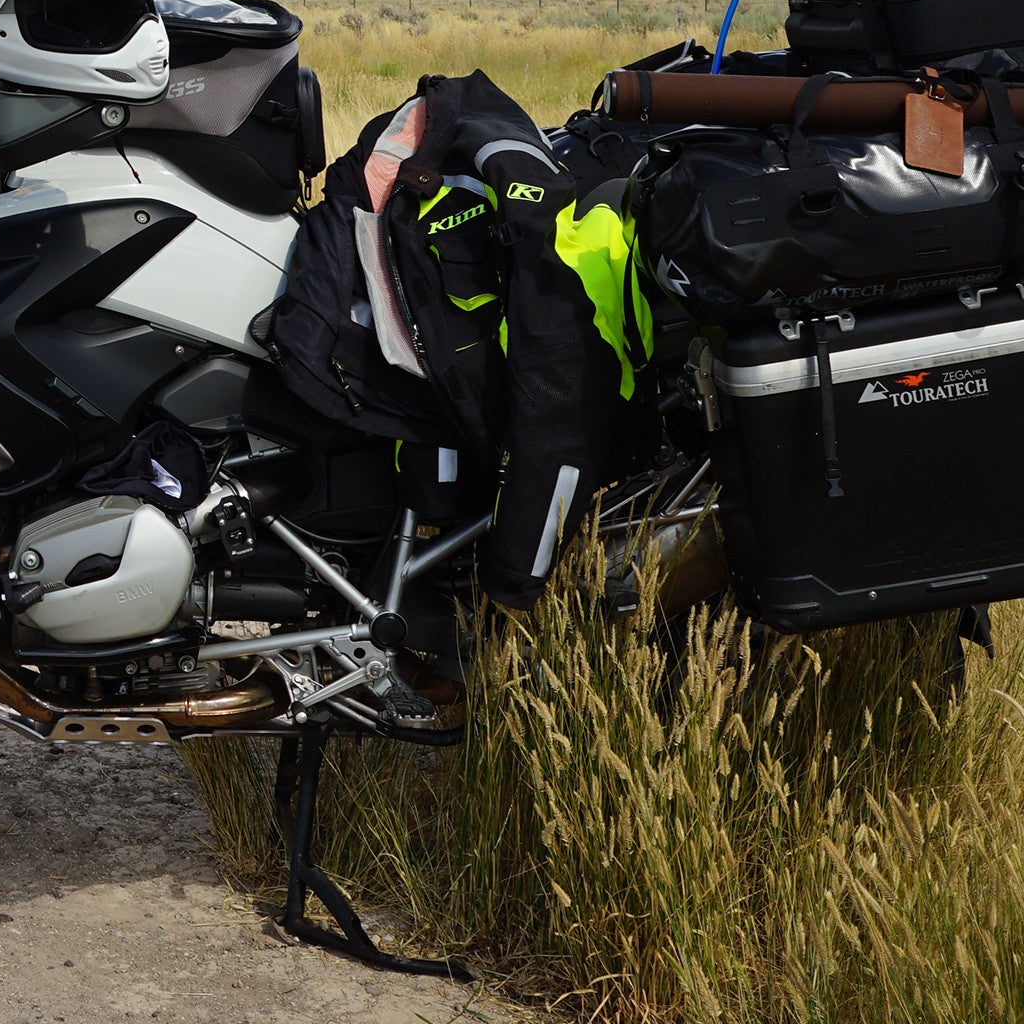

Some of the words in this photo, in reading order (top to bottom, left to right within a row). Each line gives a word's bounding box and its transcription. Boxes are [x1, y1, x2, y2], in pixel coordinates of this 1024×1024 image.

[165, 76, 206, 99] GS
[510, 183, 542, 201] K
[427, 203, 487, 235] Klim
[784, 283, 885, 307] TOURATECH
[942, 369, 973, 383] ZEGA
[972, 367, 987, 376] PRO
[889, 378, 989, 407] TOURATECH
[116, 583, 153, 605] BMW
